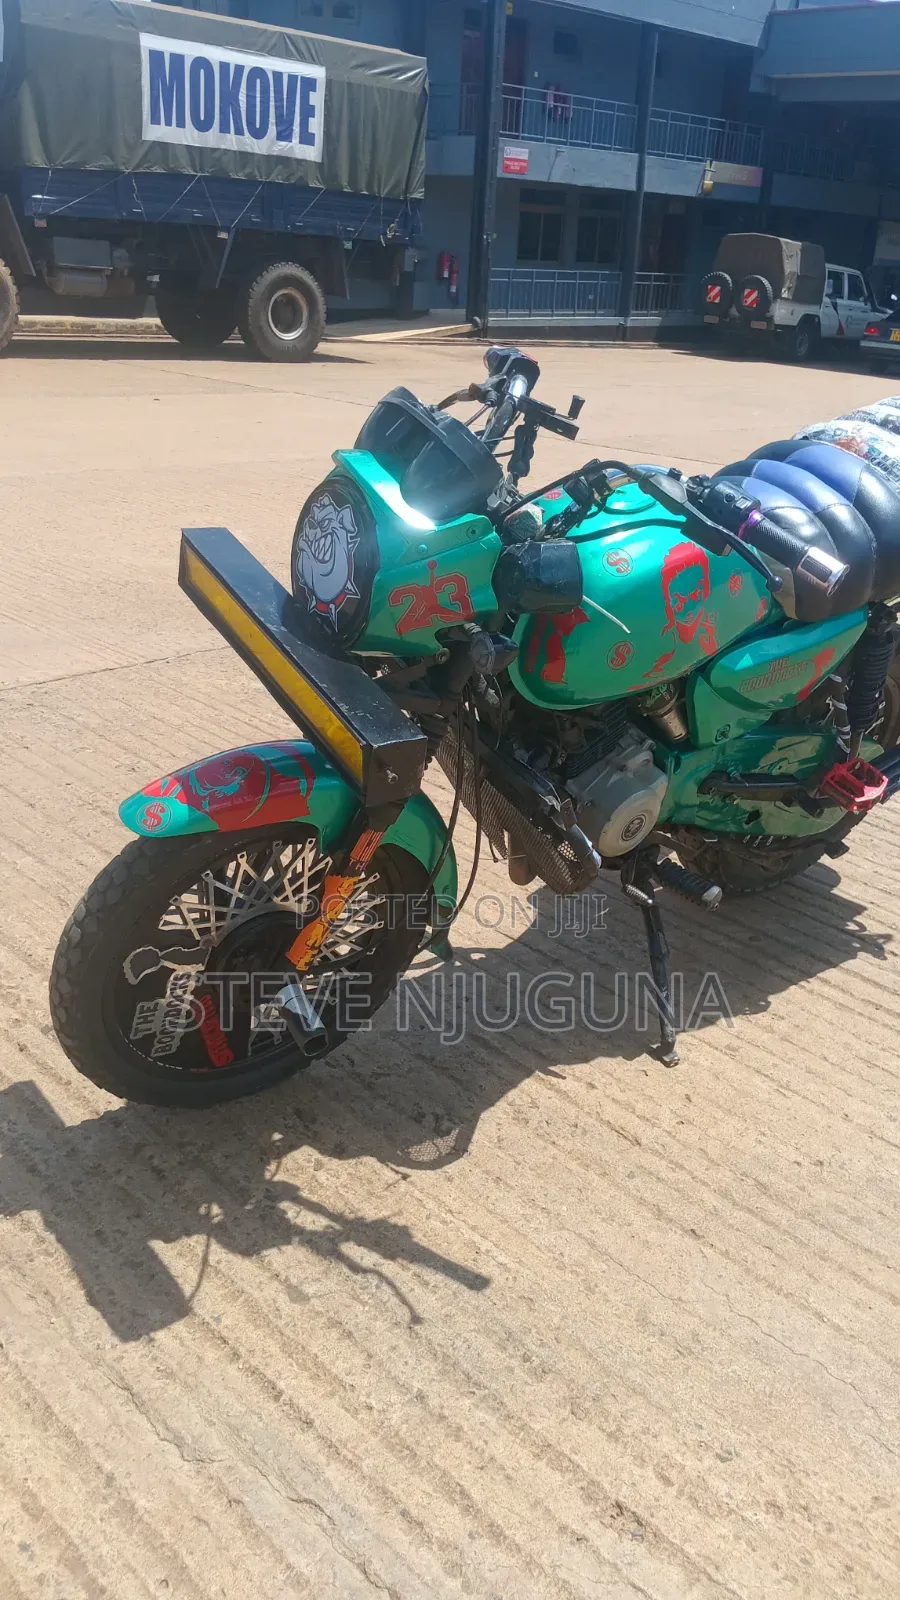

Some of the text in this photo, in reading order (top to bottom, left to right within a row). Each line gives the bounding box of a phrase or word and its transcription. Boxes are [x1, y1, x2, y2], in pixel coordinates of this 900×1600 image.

[148, 49, 317, 147] MOKOVE
[388, 571, 474, 637] 23
[132, 1001, 161, 1039] THE
